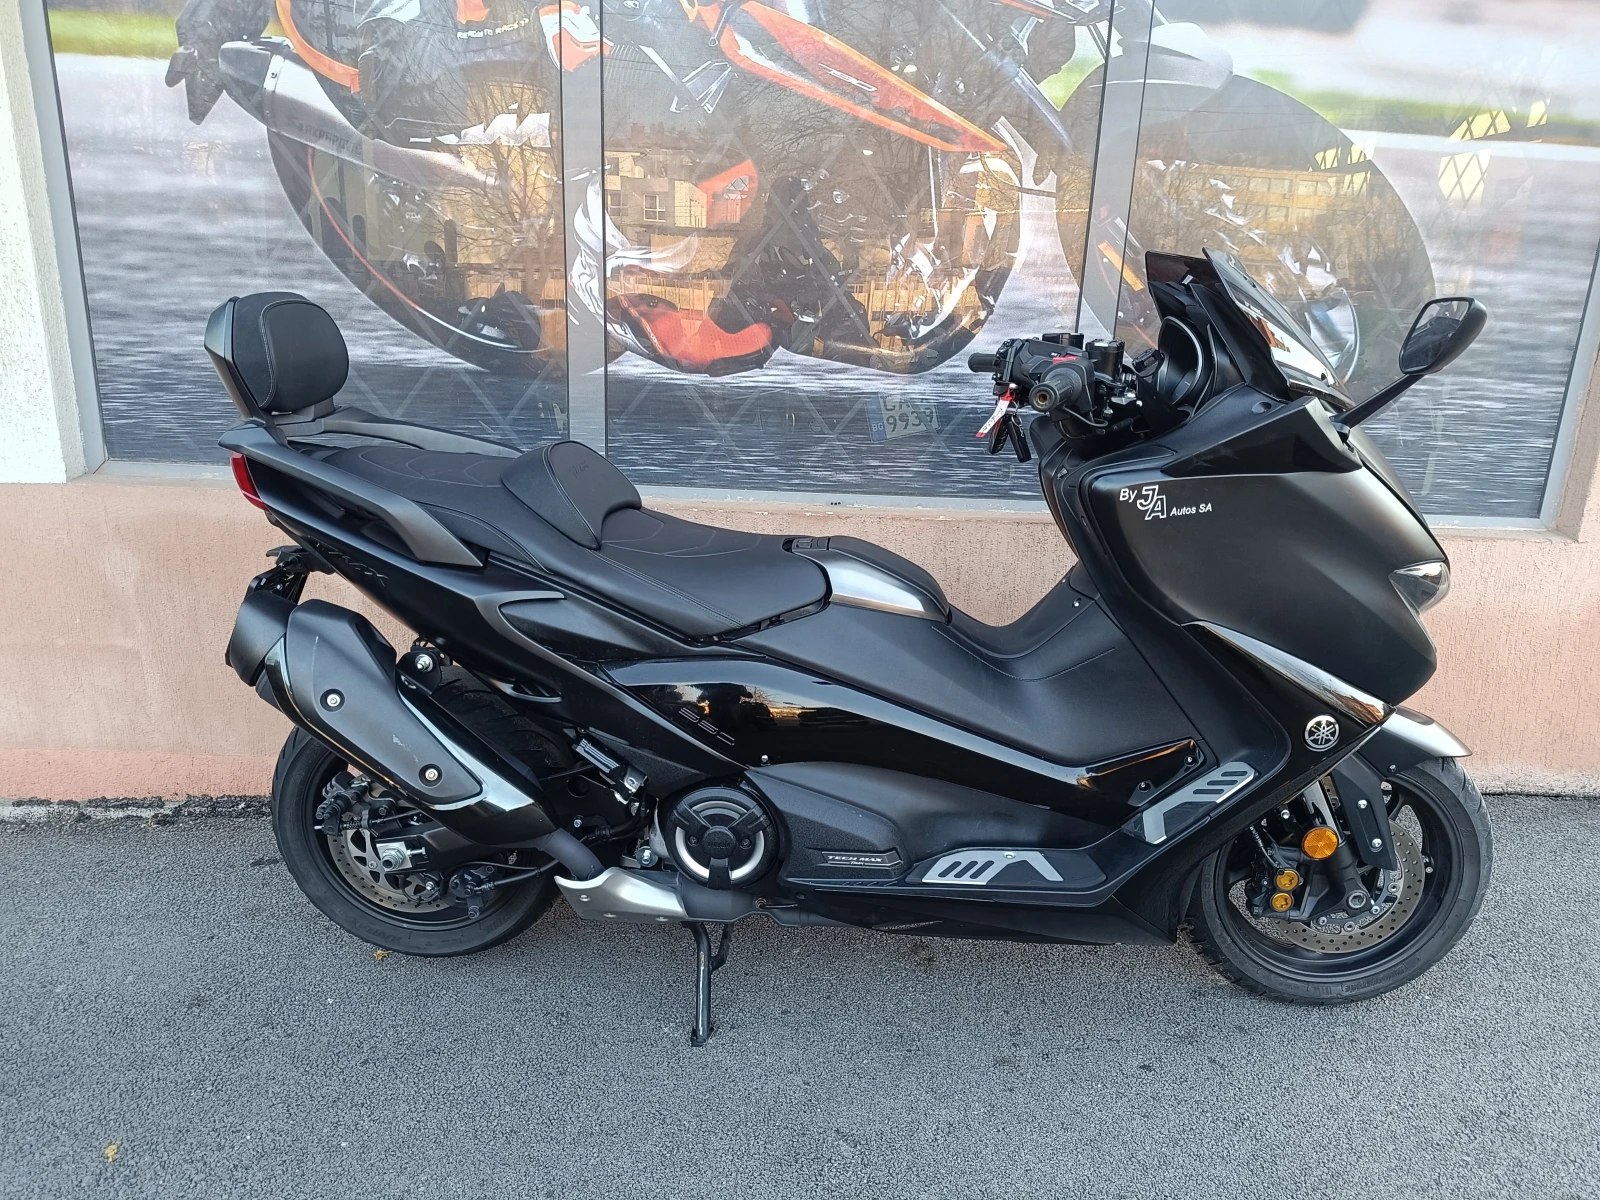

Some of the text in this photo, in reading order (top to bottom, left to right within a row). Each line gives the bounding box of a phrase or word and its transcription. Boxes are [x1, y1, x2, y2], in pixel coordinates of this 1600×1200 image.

[872, 422, 884, 432] BG
[1119, 484, 1213, 521] By JA Autos SA
